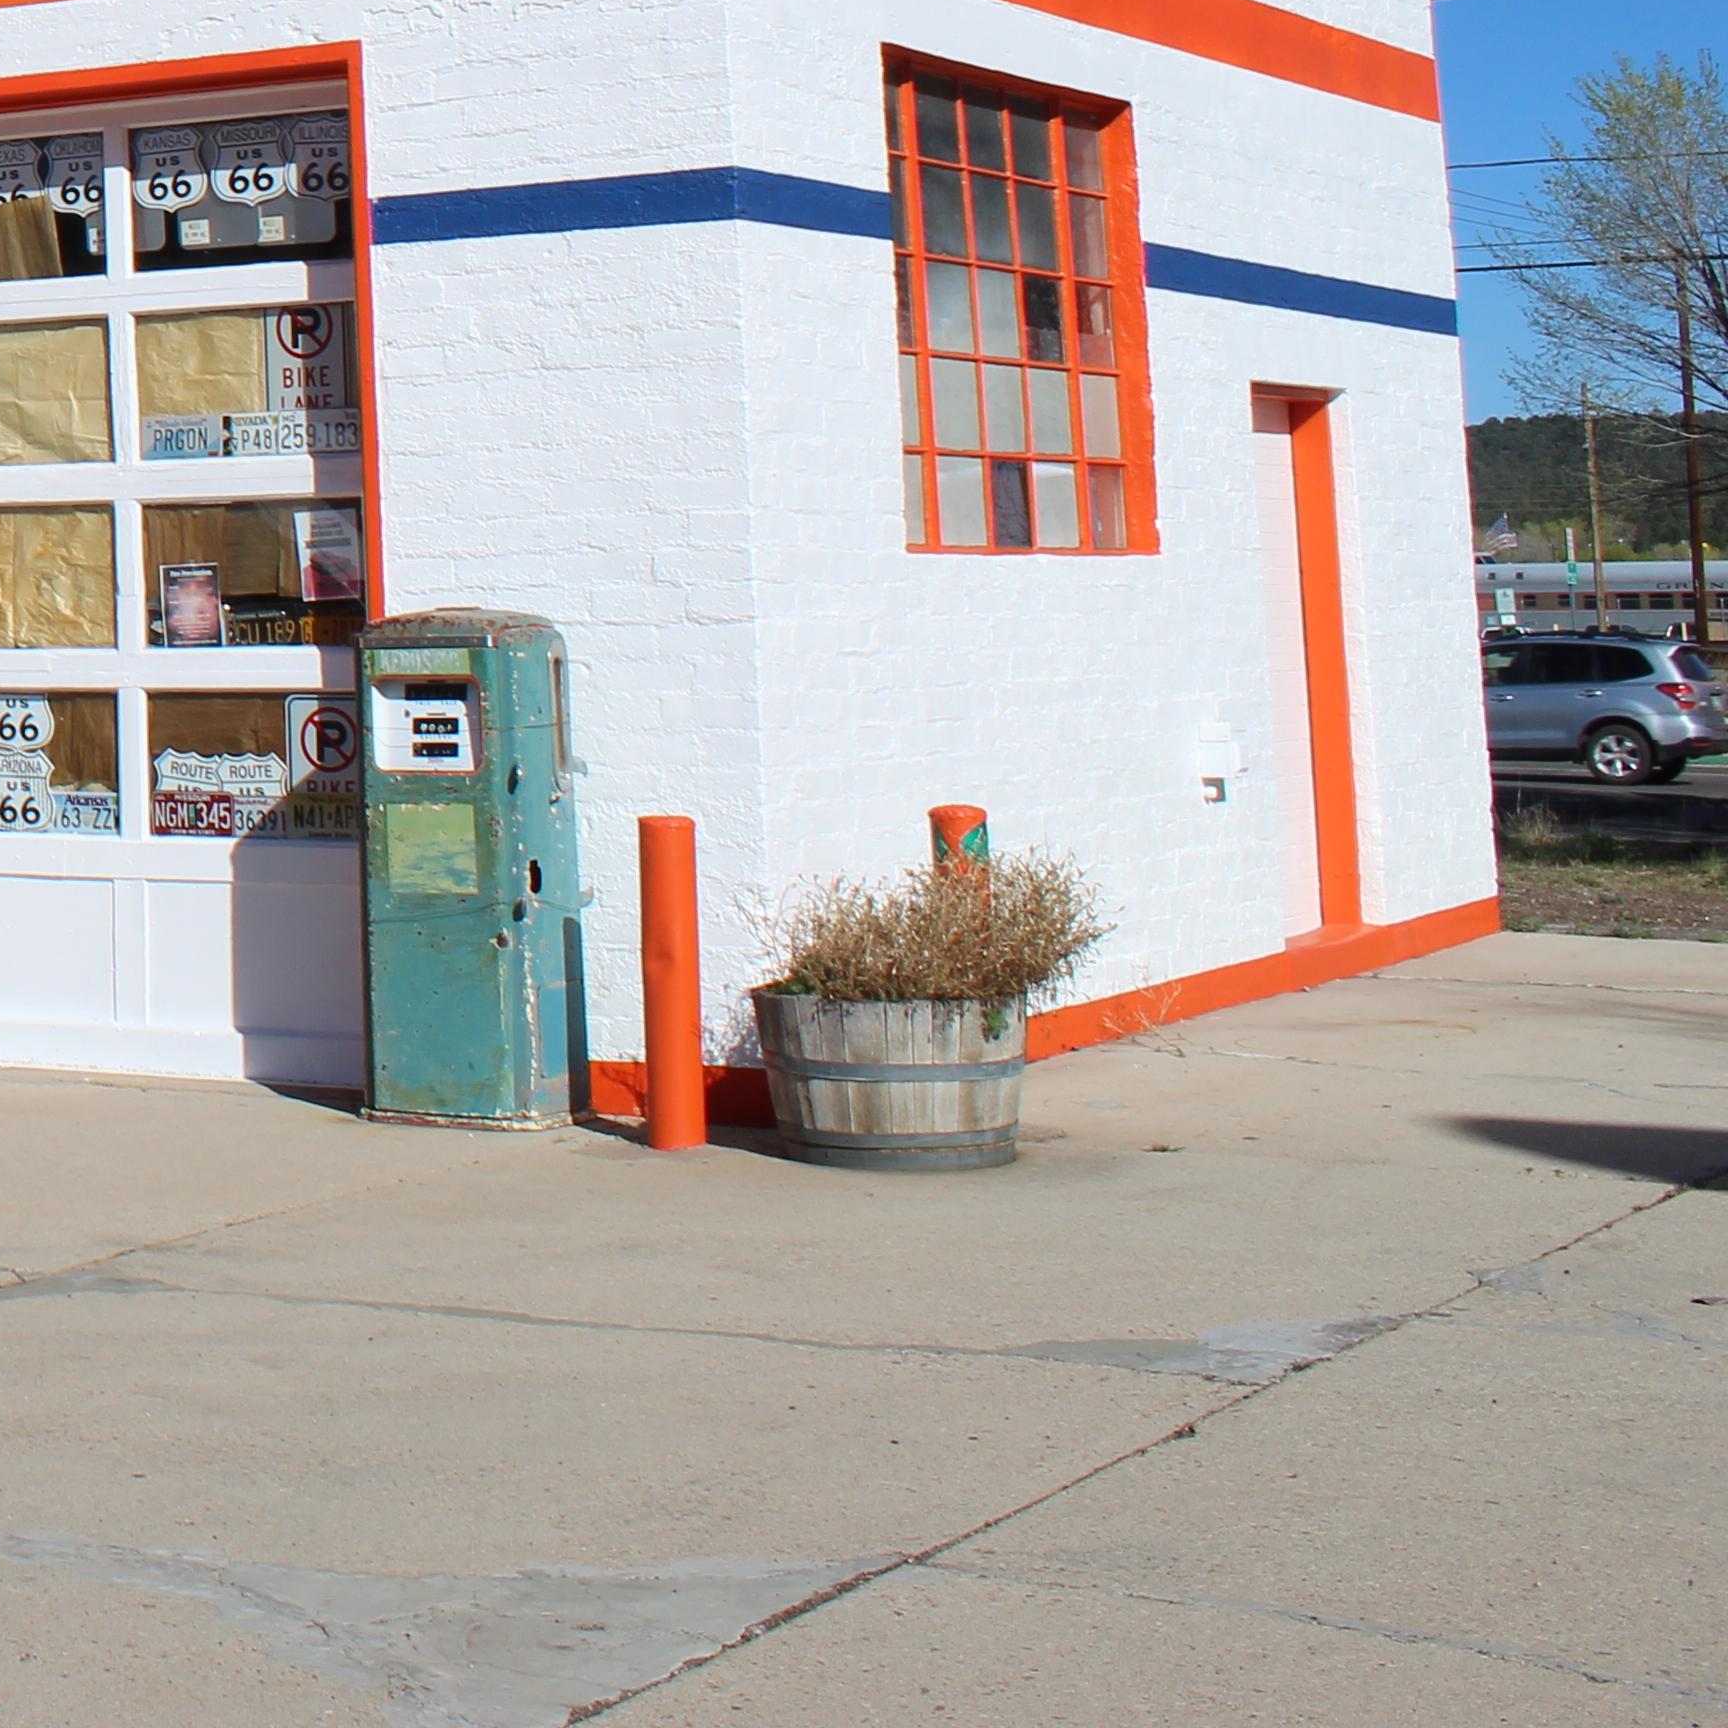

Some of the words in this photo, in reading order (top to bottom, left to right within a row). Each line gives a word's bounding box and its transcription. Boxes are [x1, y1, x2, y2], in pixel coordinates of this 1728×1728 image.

[143, 132, 191, 150] KANSAS
[220, 125, 277, 143] MISSOURI
[236, 148, 263, 160] US
[311, 147, 339, 158] US
[68, 160, 93, 172] US
[155, 155, 180, 167] US
[228, 162, 274, 195] 66
[301, 161, 350, 193] 66
[61, 174, 103, 206] 66
[149, 169, 192, 201] 66
[282, 366, 332, 389] BIKE
[231, 415, 269, 427] NEVADA
[5, 697, 29, 709] US
[170, 761, 214, 780] ROUTE
[229, 764, 274, 779] ROUTE
[6, 781, 31, 792] US
[306, 780, 356, 793] BIKE
[65, 794, 109, 807] Arkansas
[154, 801, 190, 828] NGM
[196, 802, 232, 829] 345
